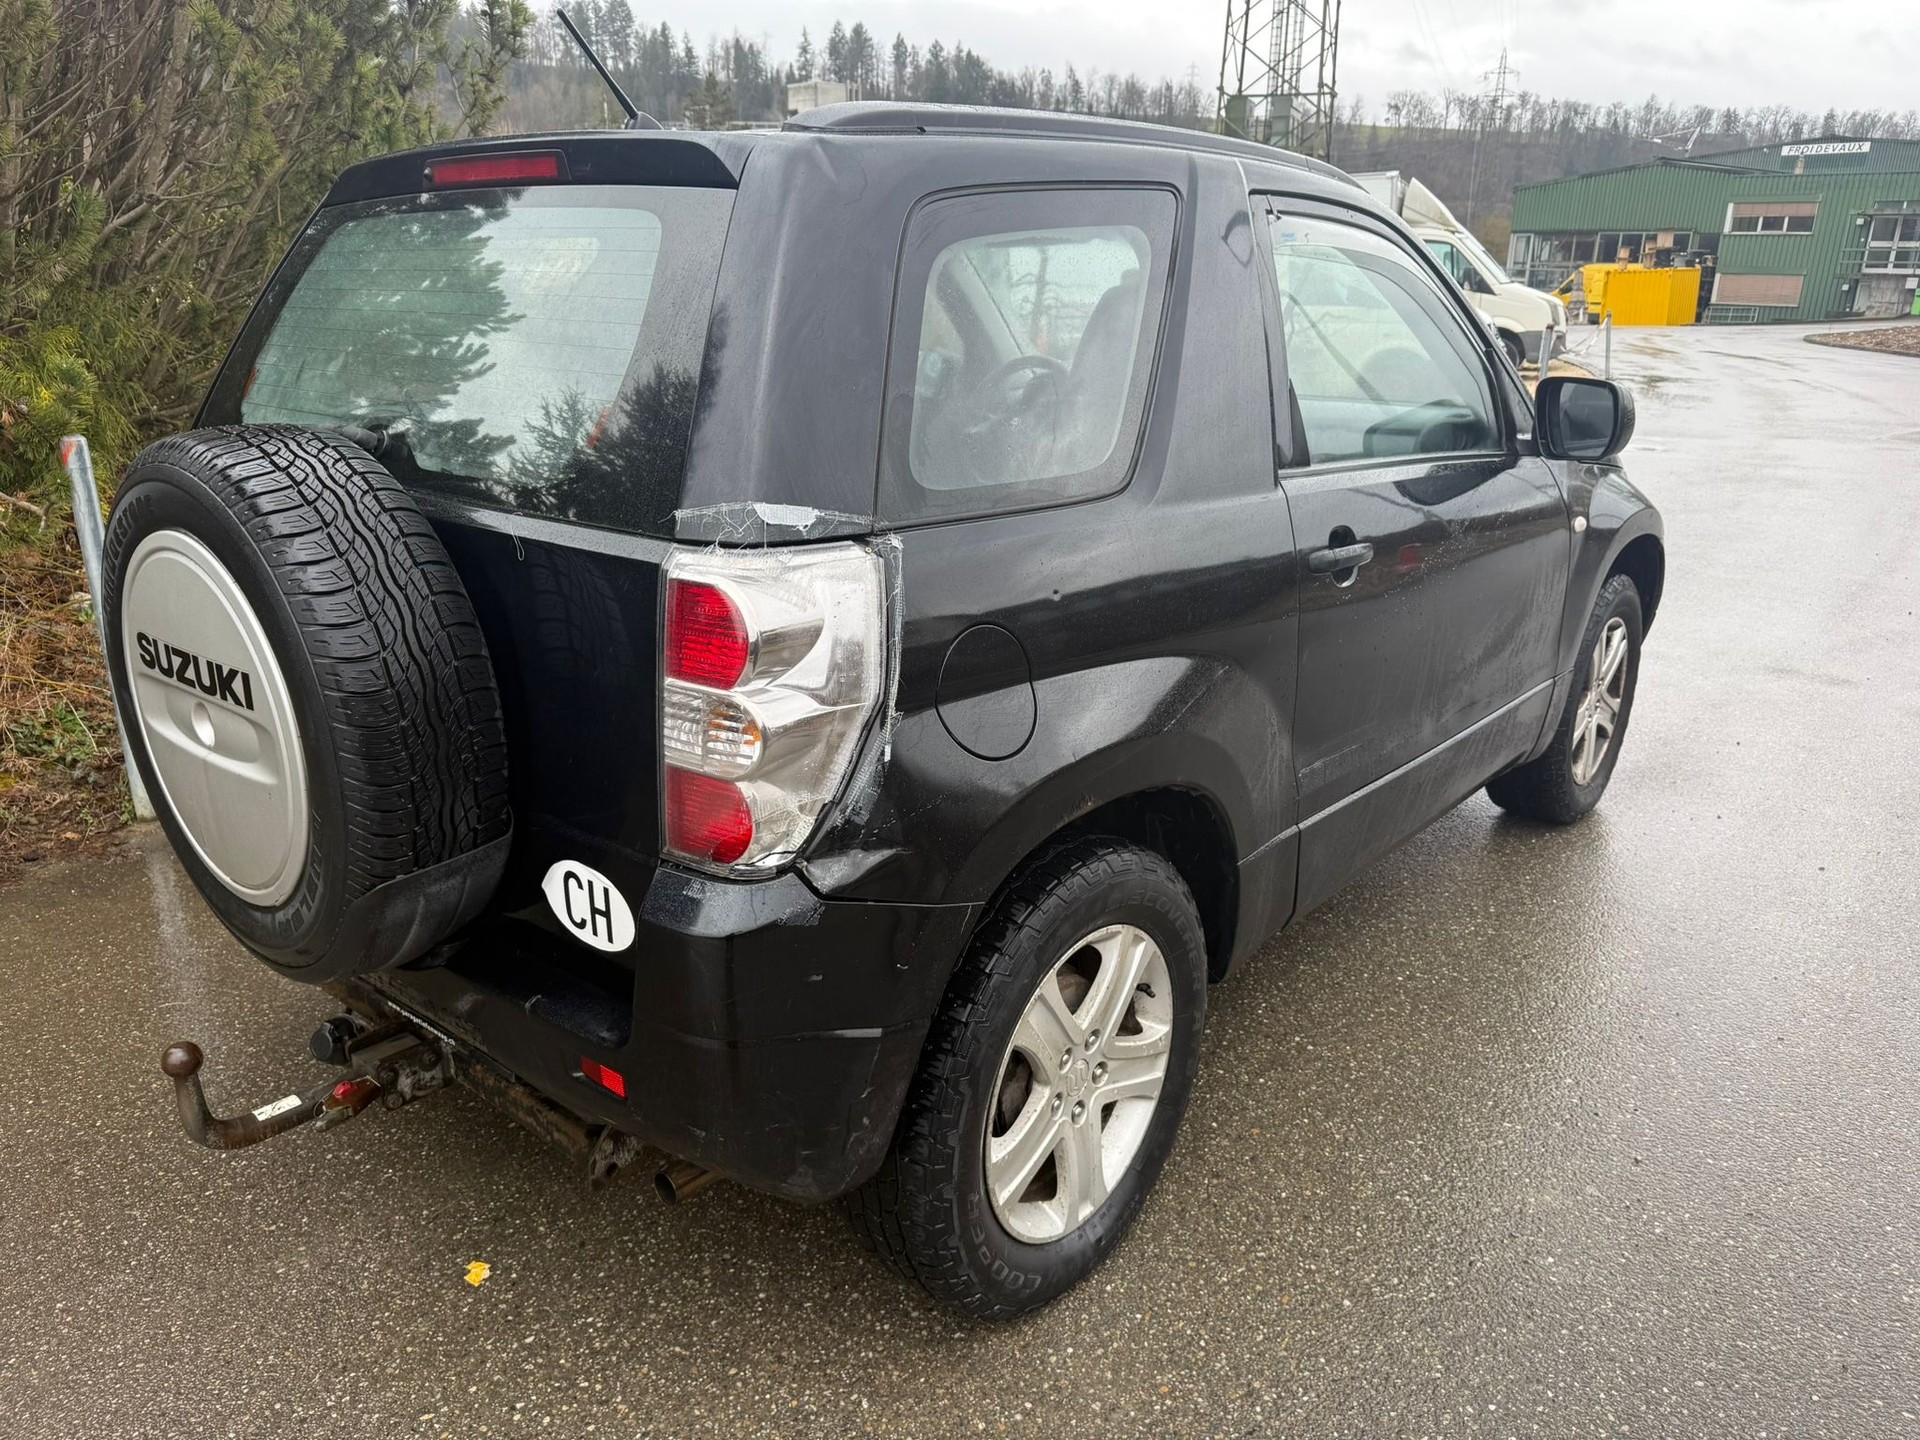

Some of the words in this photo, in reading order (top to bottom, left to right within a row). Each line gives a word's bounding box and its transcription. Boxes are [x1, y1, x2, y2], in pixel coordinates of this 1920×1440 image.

[1787, 143, 1865, 155] FROIDEVAUX
[136, 631, 255, 711] SUZUKI
[563, 869, 614, 944] CH
